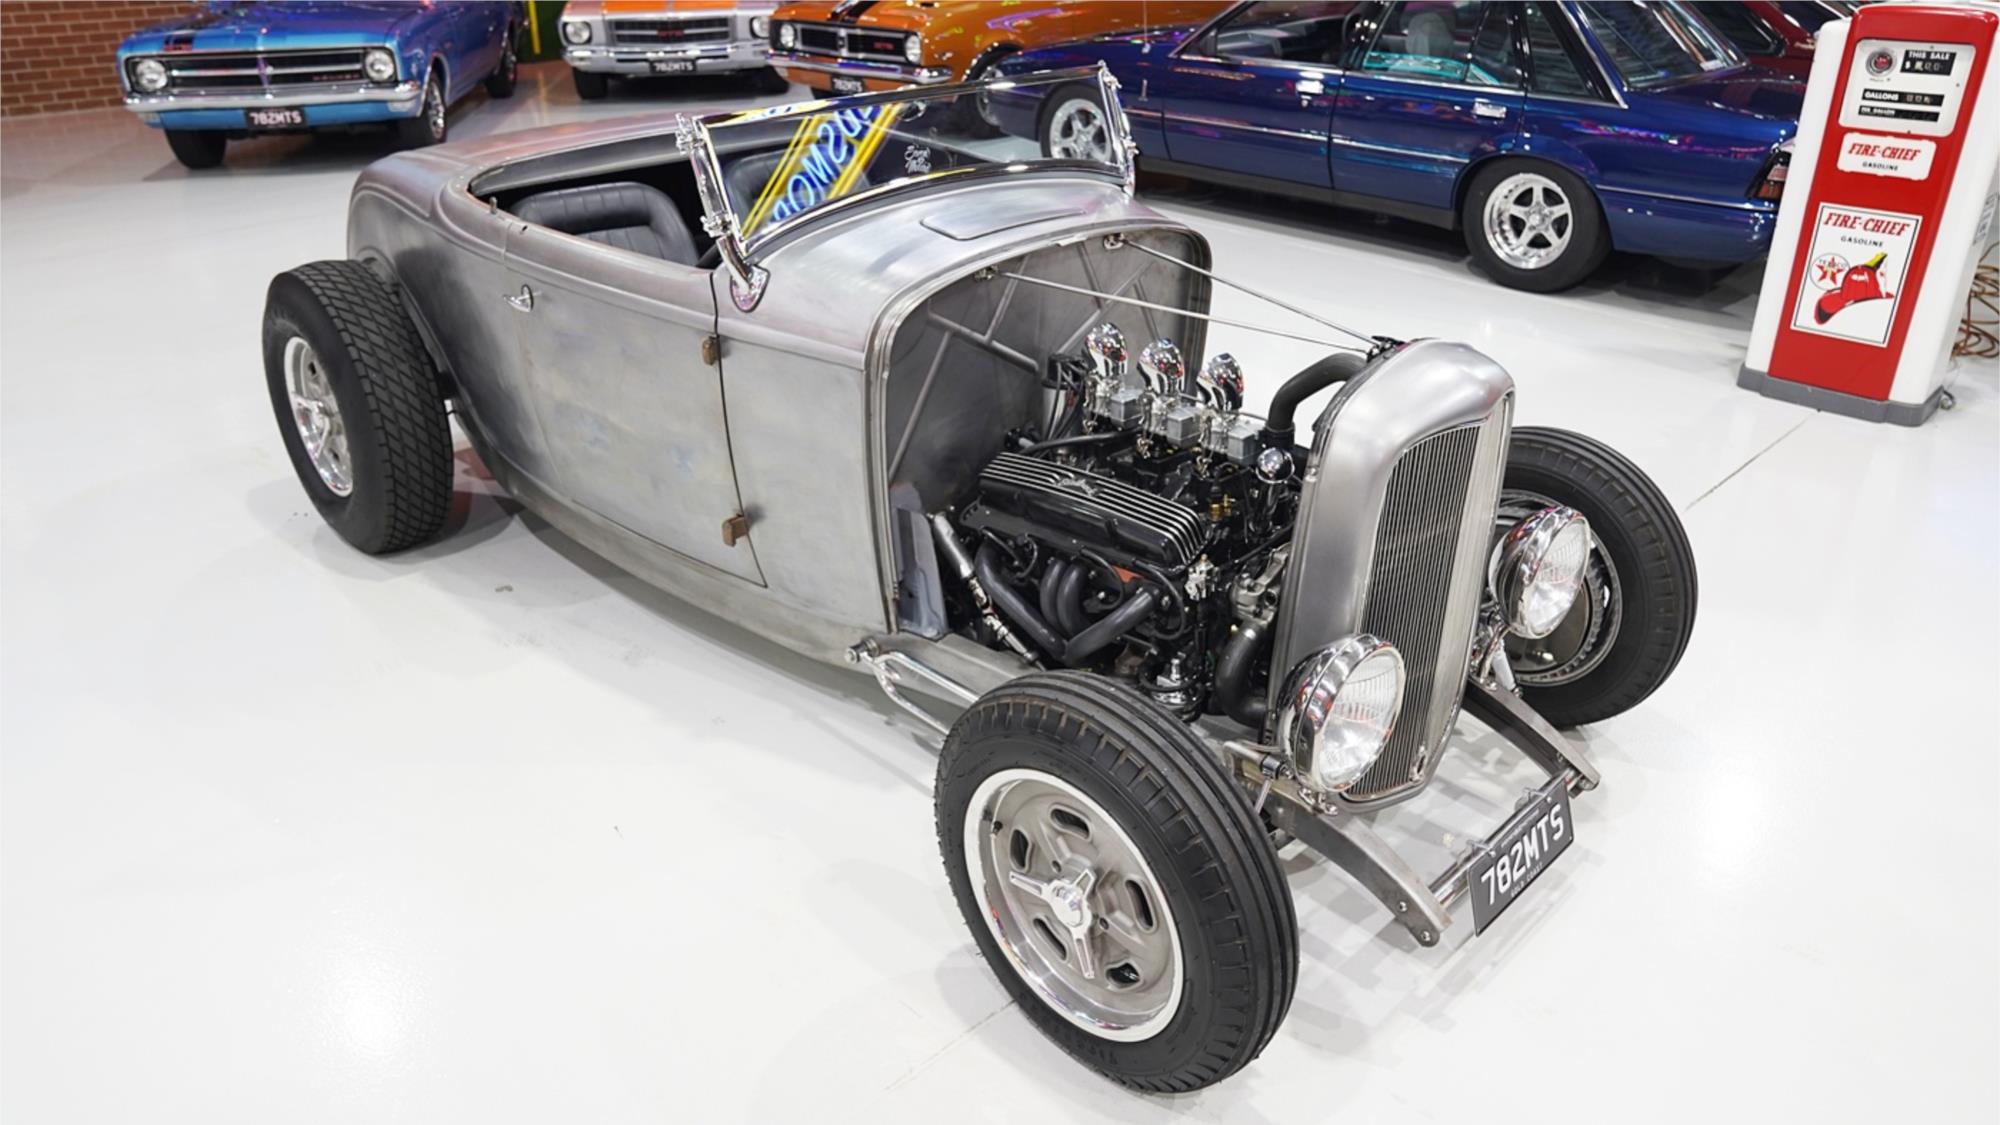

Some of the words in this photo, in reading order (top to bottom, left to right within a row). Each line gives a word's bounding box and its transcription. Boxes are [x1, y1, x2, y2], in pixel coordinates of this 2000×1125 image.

[1908, 51, 1926, 60] THIS
[1929, 52, 1950, 61] SALE
[1863, 90, 1899, 101] GALLONS
[1848, 143, 1921, 161] FIRE-CHIEF
[1862, 161, 1898, 171] GASOLINE
[1823, 211, 1911, 236] FIRE-CHIEF
[1841, 235, 1884, 247] GASOLINE
[1481, 803, 1564, 905] 782MTS
